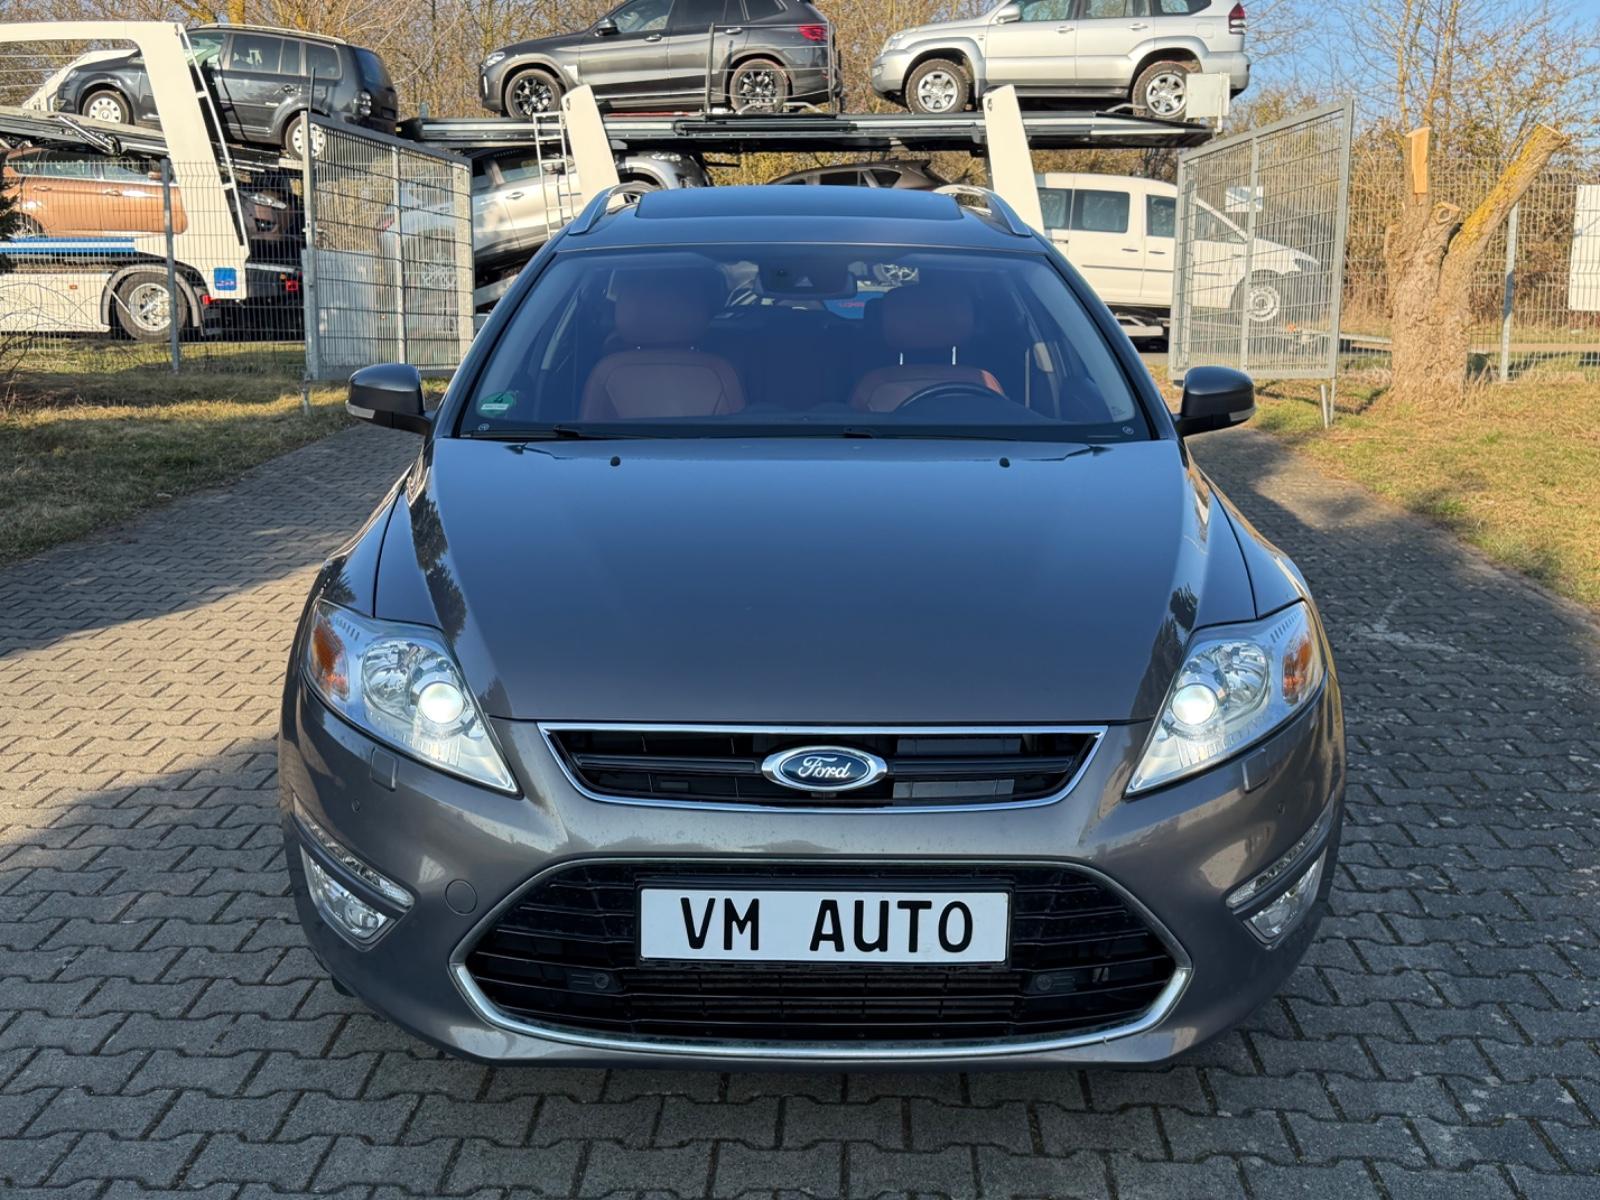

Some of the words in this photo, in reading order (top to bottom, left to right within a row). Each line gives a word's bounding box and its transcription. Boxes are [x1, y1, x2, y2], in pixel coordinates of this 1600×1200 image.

[798, 756, 851, 778] Ford
[680, 897, 760, 951] VM
[809, 899, 973, 953] AUTO
